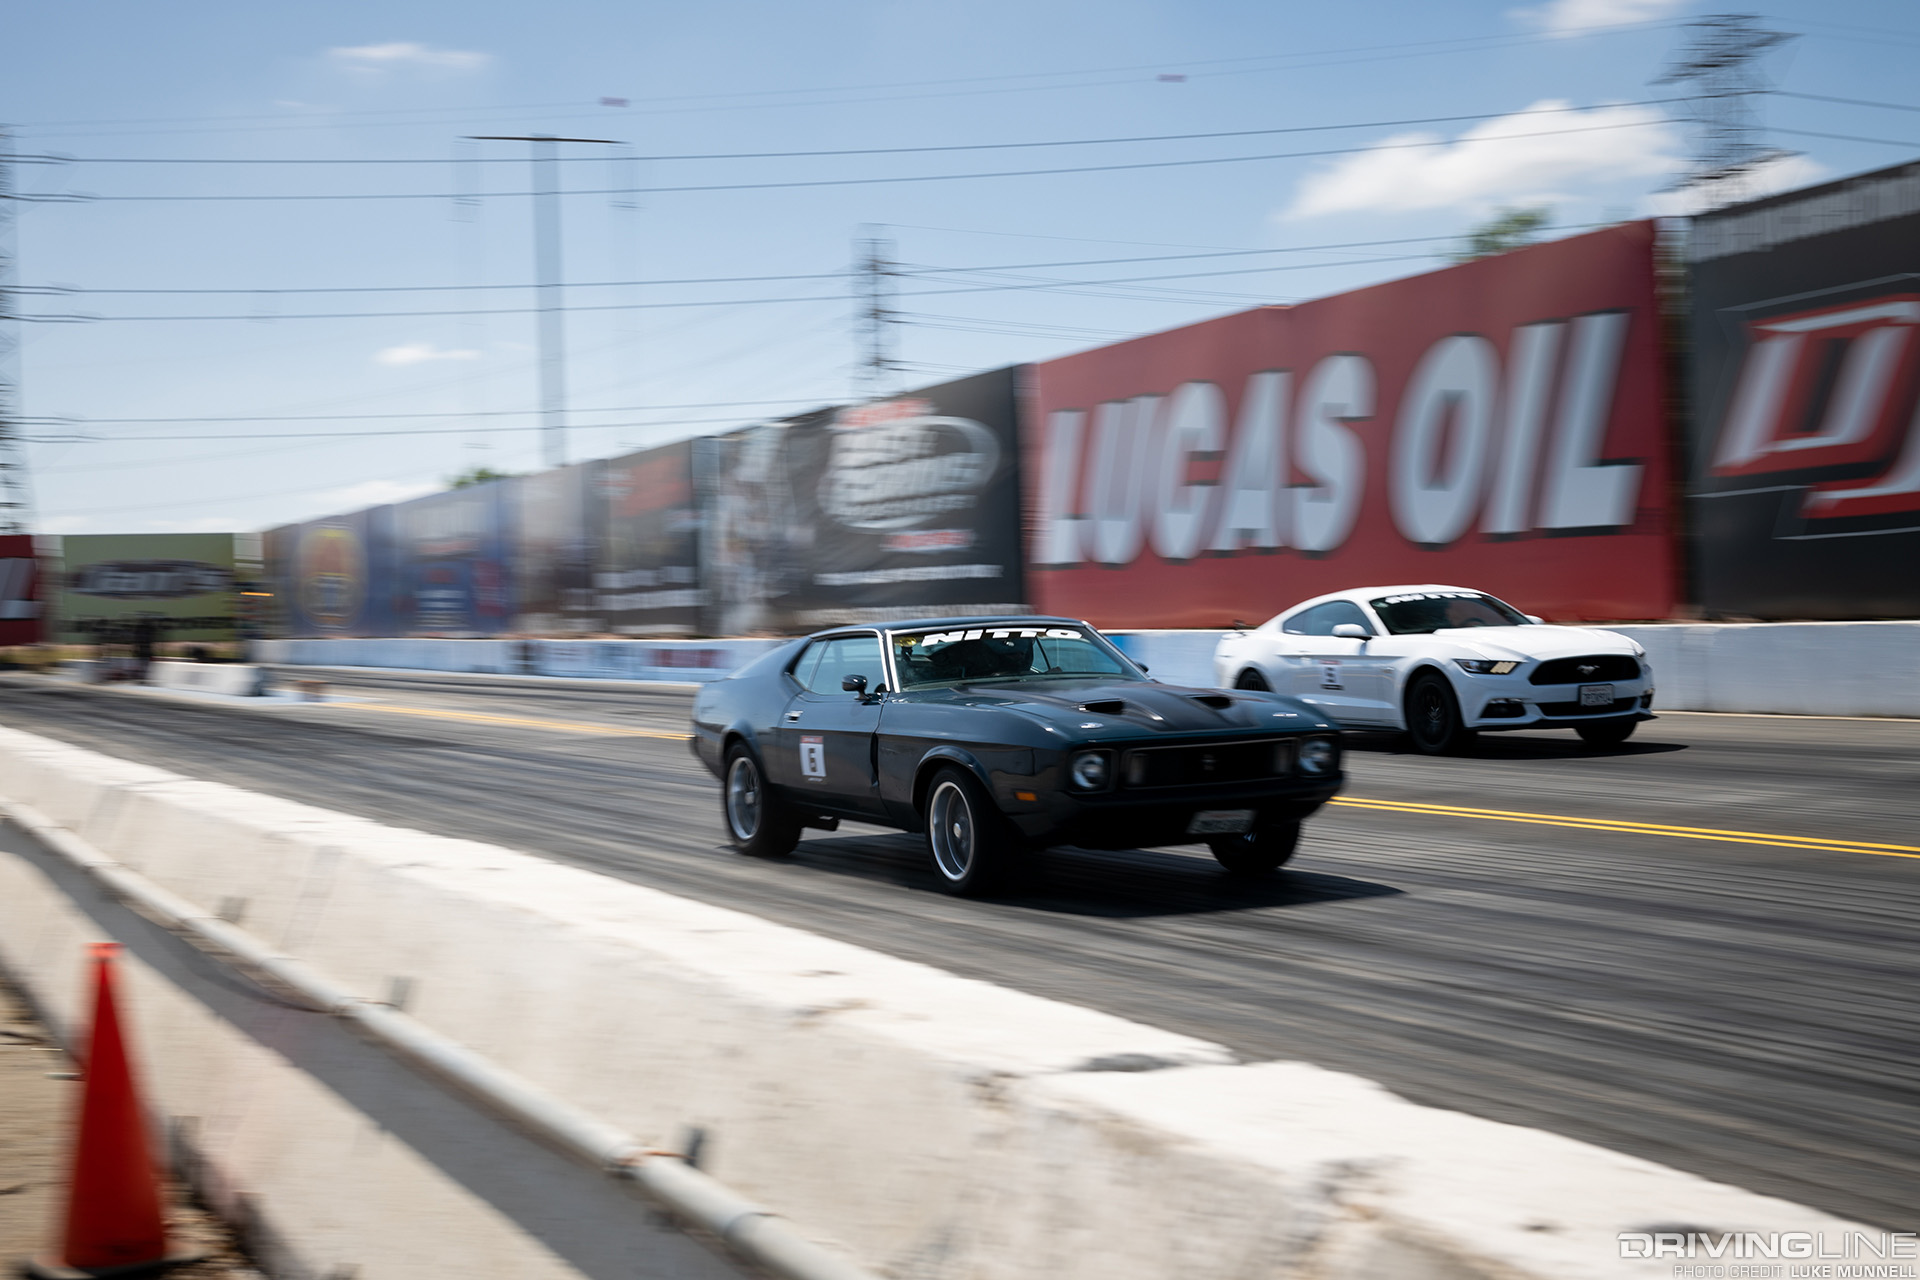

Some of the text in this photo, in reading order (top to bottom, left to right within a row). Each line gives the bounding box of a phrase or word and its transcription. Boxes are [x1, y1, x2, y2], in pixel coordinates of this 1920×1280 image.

[1033, 353, 1378, 571] LUCAS
[1389, 310, 1645, 543] OIL
[920, 628, 1083, 647] NITTO
